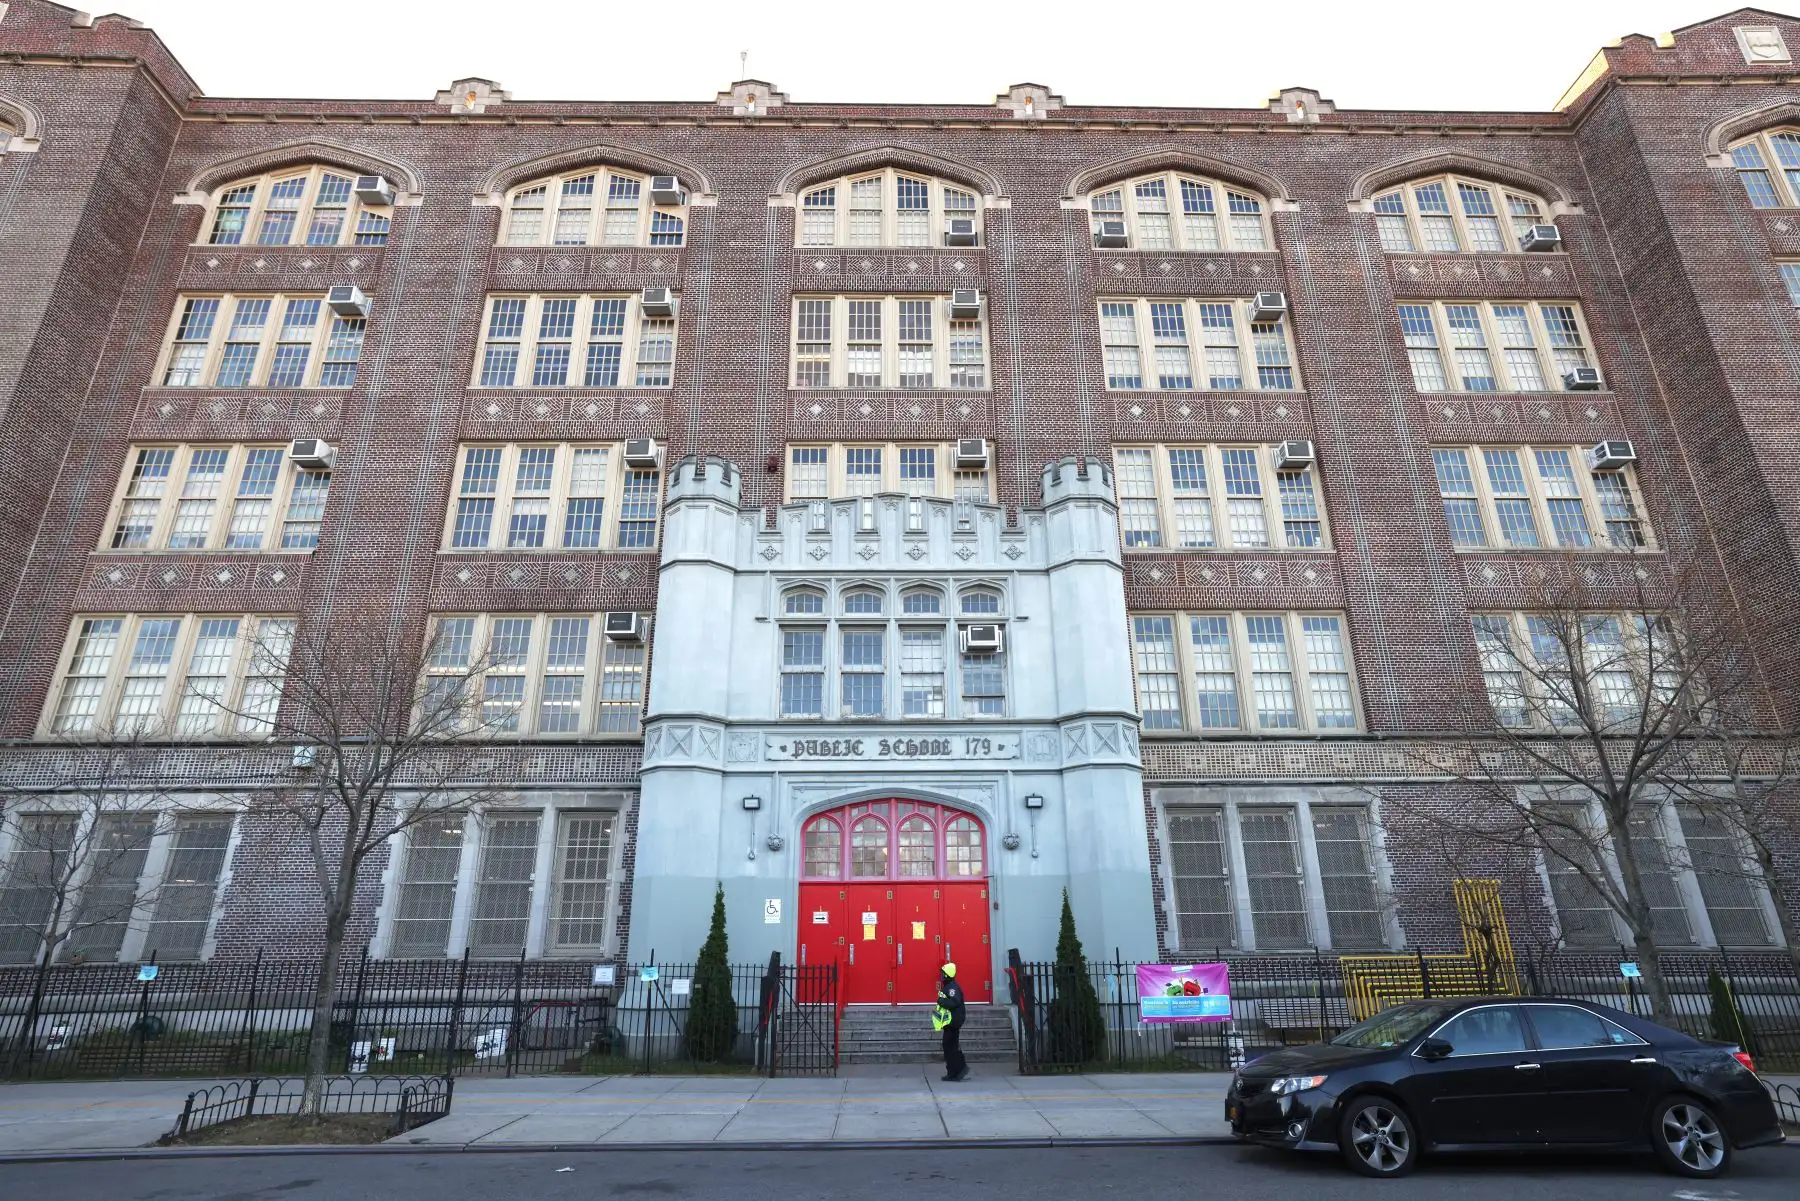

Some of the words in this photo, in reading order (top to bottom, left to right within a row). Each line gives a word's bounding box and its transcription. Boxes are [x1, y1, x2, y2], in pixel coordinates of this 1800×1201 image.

[791, 738, 865, 759] PUBLIC
[878, 738, 953, 757] SCHOOL
[965, 737, 992, 756] 179
